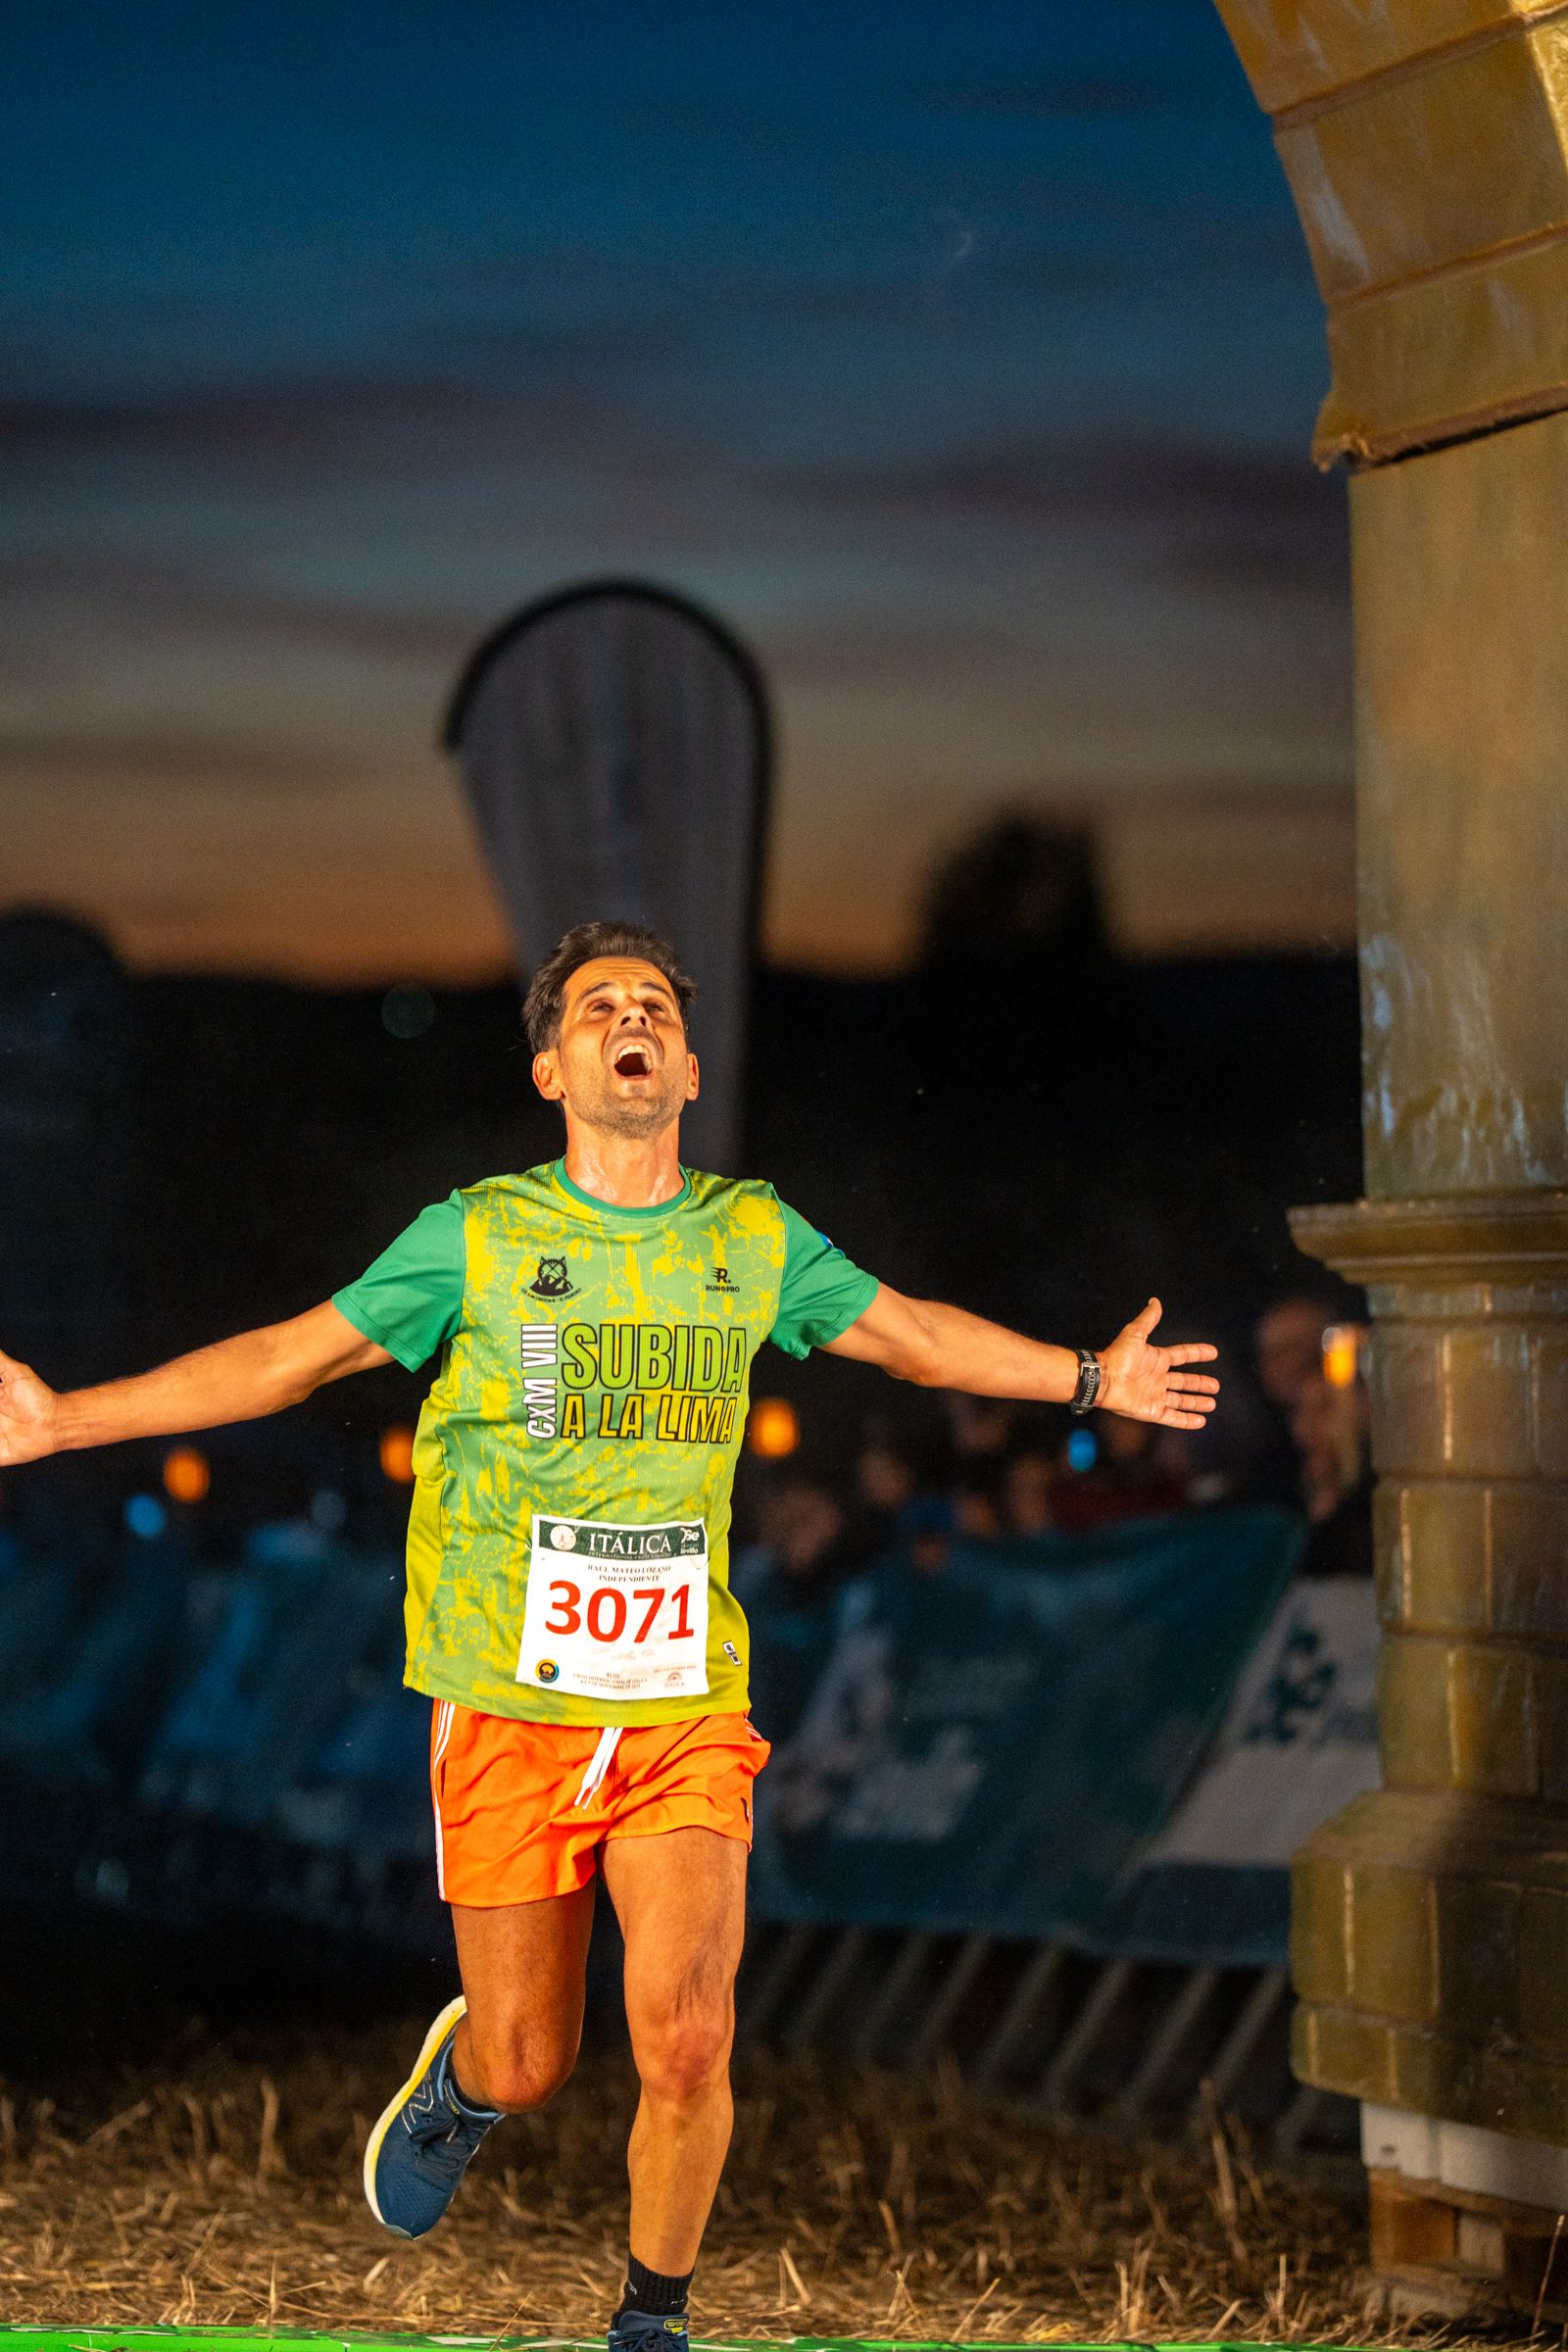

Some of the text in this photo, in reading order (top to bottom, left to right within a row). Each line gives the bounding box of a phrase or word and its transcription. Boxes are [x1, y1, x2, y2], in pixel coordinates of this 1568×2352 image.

[520, 1323, 559, 1370] VIII
[561, 1323, 747, 1394] SUBIDA
[561, 1394, 738, 1445] A LA LIMA
[588, 1531, 672, 1555] ITÁLICA
[545, 1579, 695, 1643] 3071
